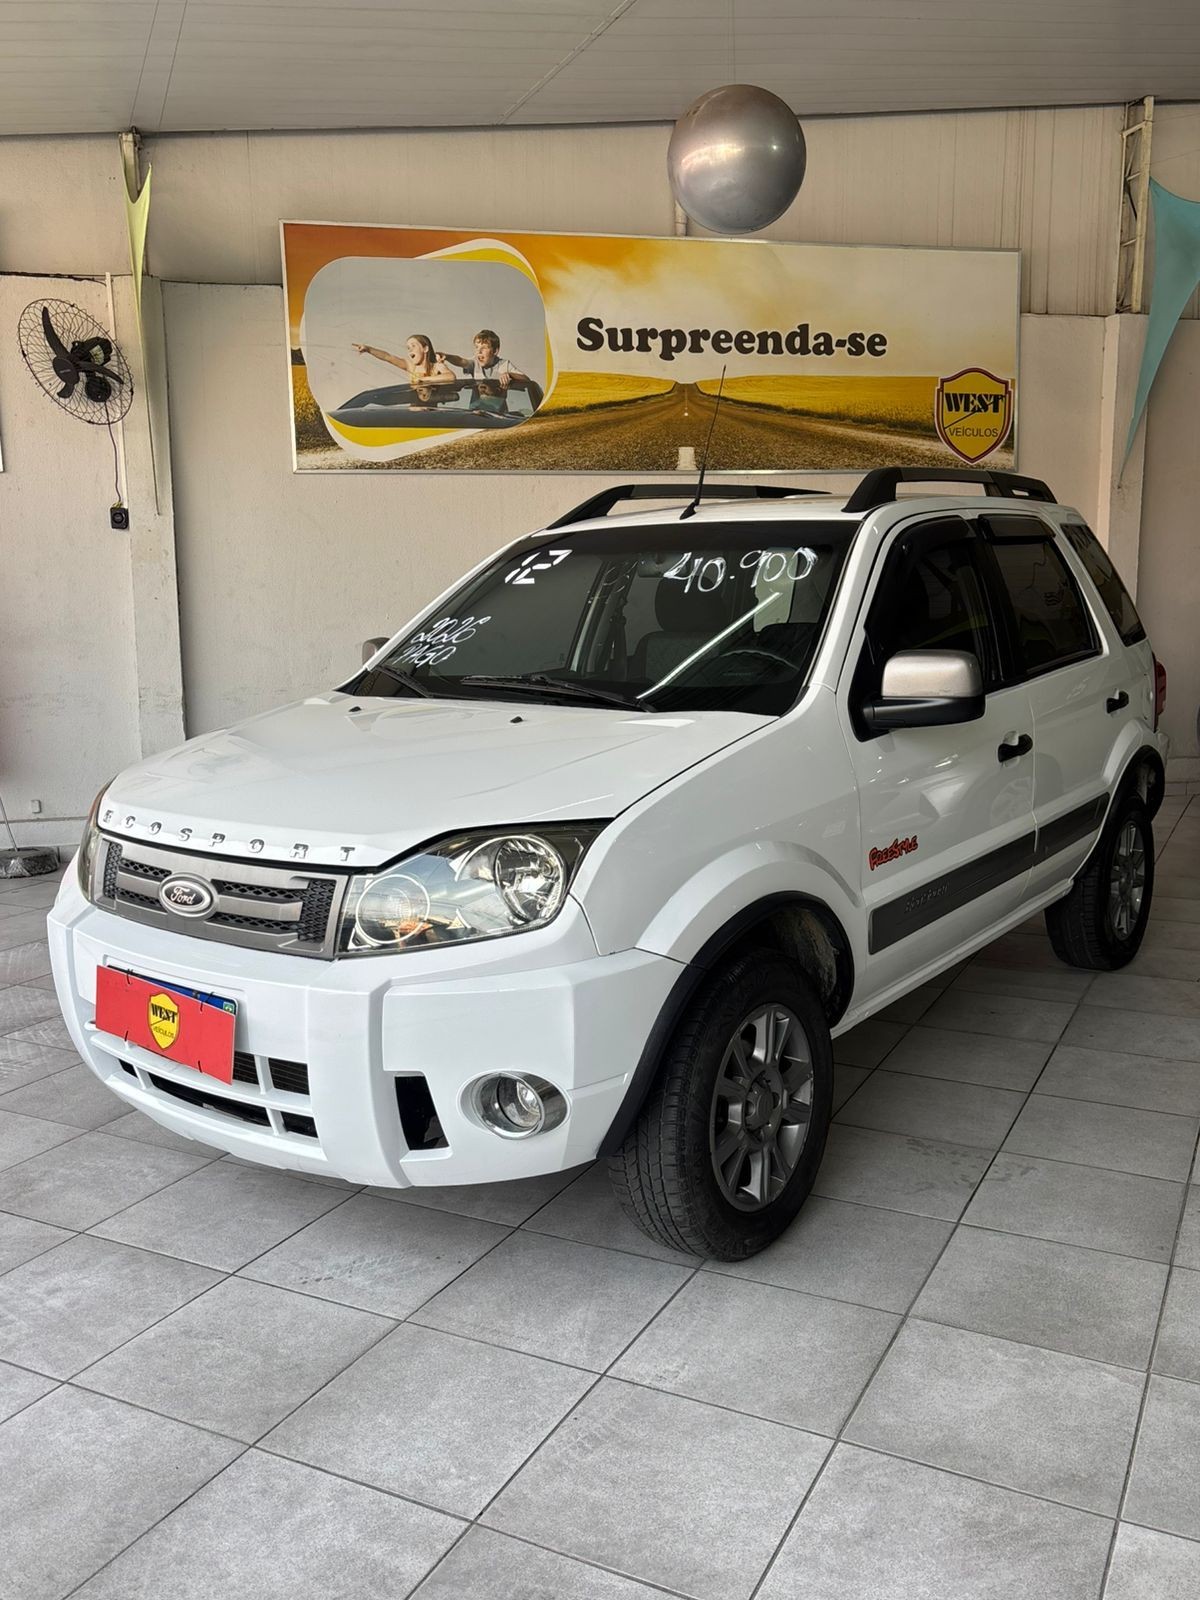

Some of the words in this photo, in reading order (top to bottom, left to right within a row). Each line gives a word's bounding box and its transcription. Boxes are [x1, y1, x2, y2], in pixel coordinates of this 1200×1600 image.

[577, 317, 888, 361] Surpreenda-se
[944, 392, 1006, 413] WEST
[949, 426, 999, 438] VEÍCULOS
[663, 547, 818, 593] 40.900
[103, 809, 356, 861] ECOSPORT
[170, 887, 196, 906] Ford
[151, 1003, 178, 1024] WEST
